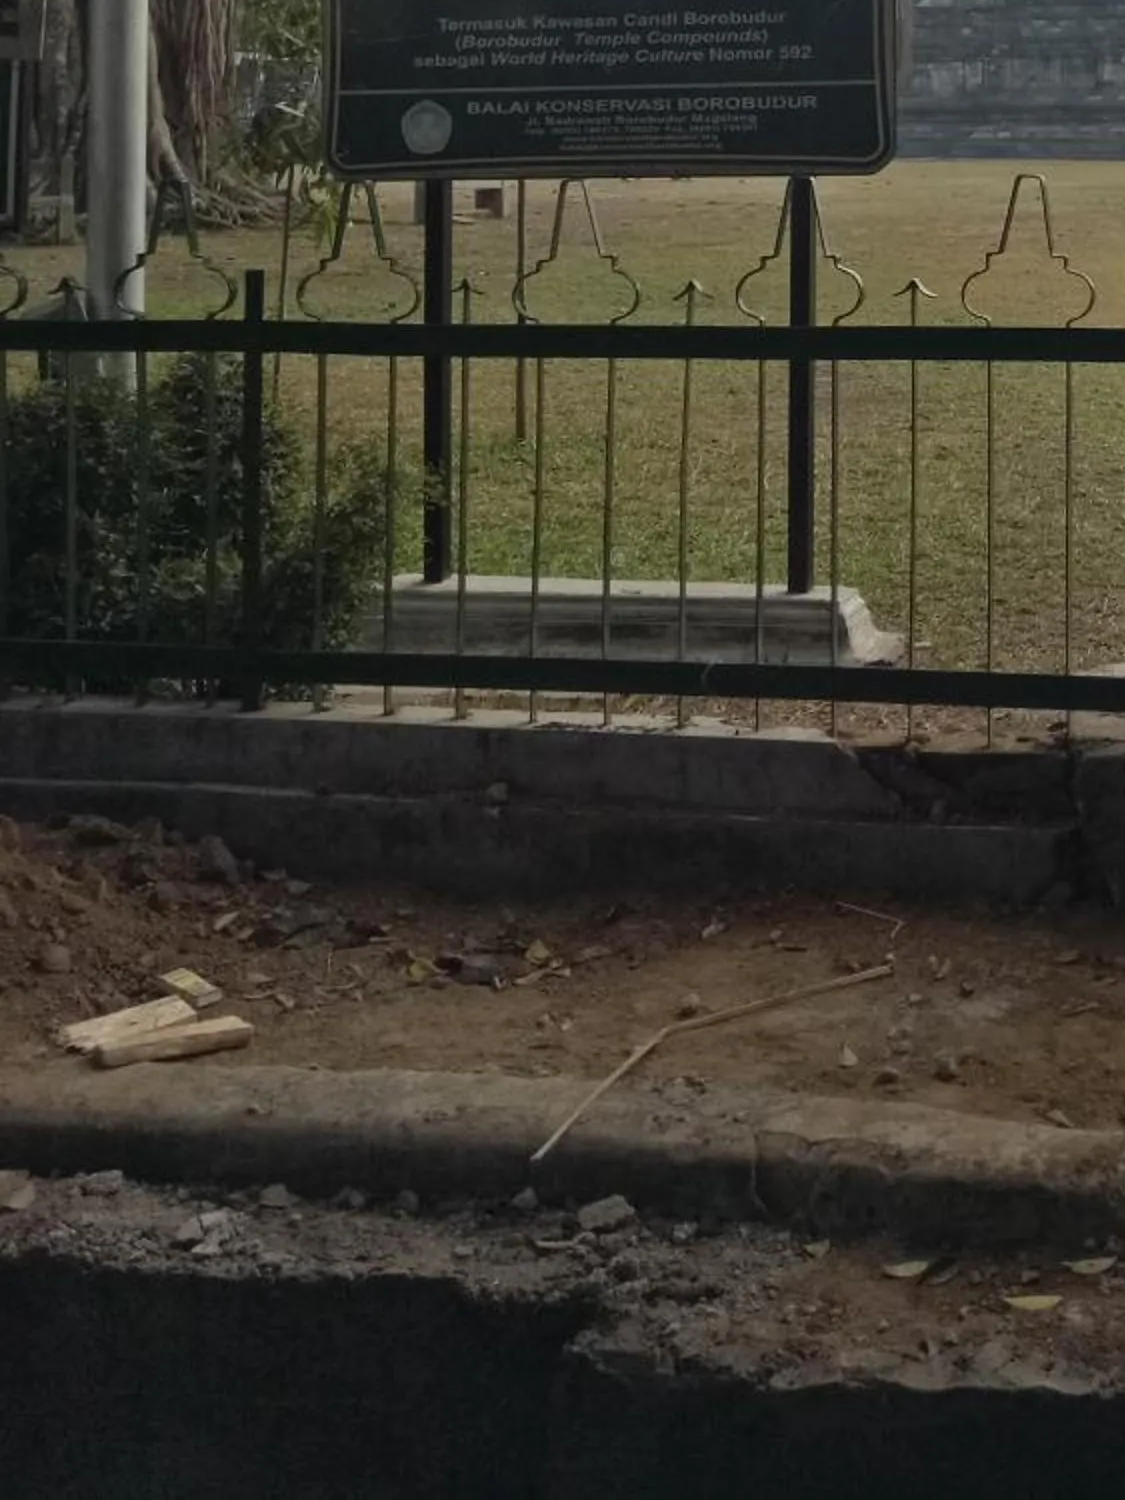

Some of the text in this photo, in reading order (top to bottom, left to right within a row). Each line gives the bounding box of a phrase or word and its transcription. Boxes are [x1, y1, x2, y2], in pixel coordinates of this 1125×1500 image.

[624, 12, 678, 28] Candi
[684, 8, 786, 25] Borobudur
[574, 31, 641, 49] Temple
[491, 51, 546, 66] World
[551, 50, 629, 67] Heritage
[467, 95, 818, 115] BALAI KONSERVASI BOROBUDUR
